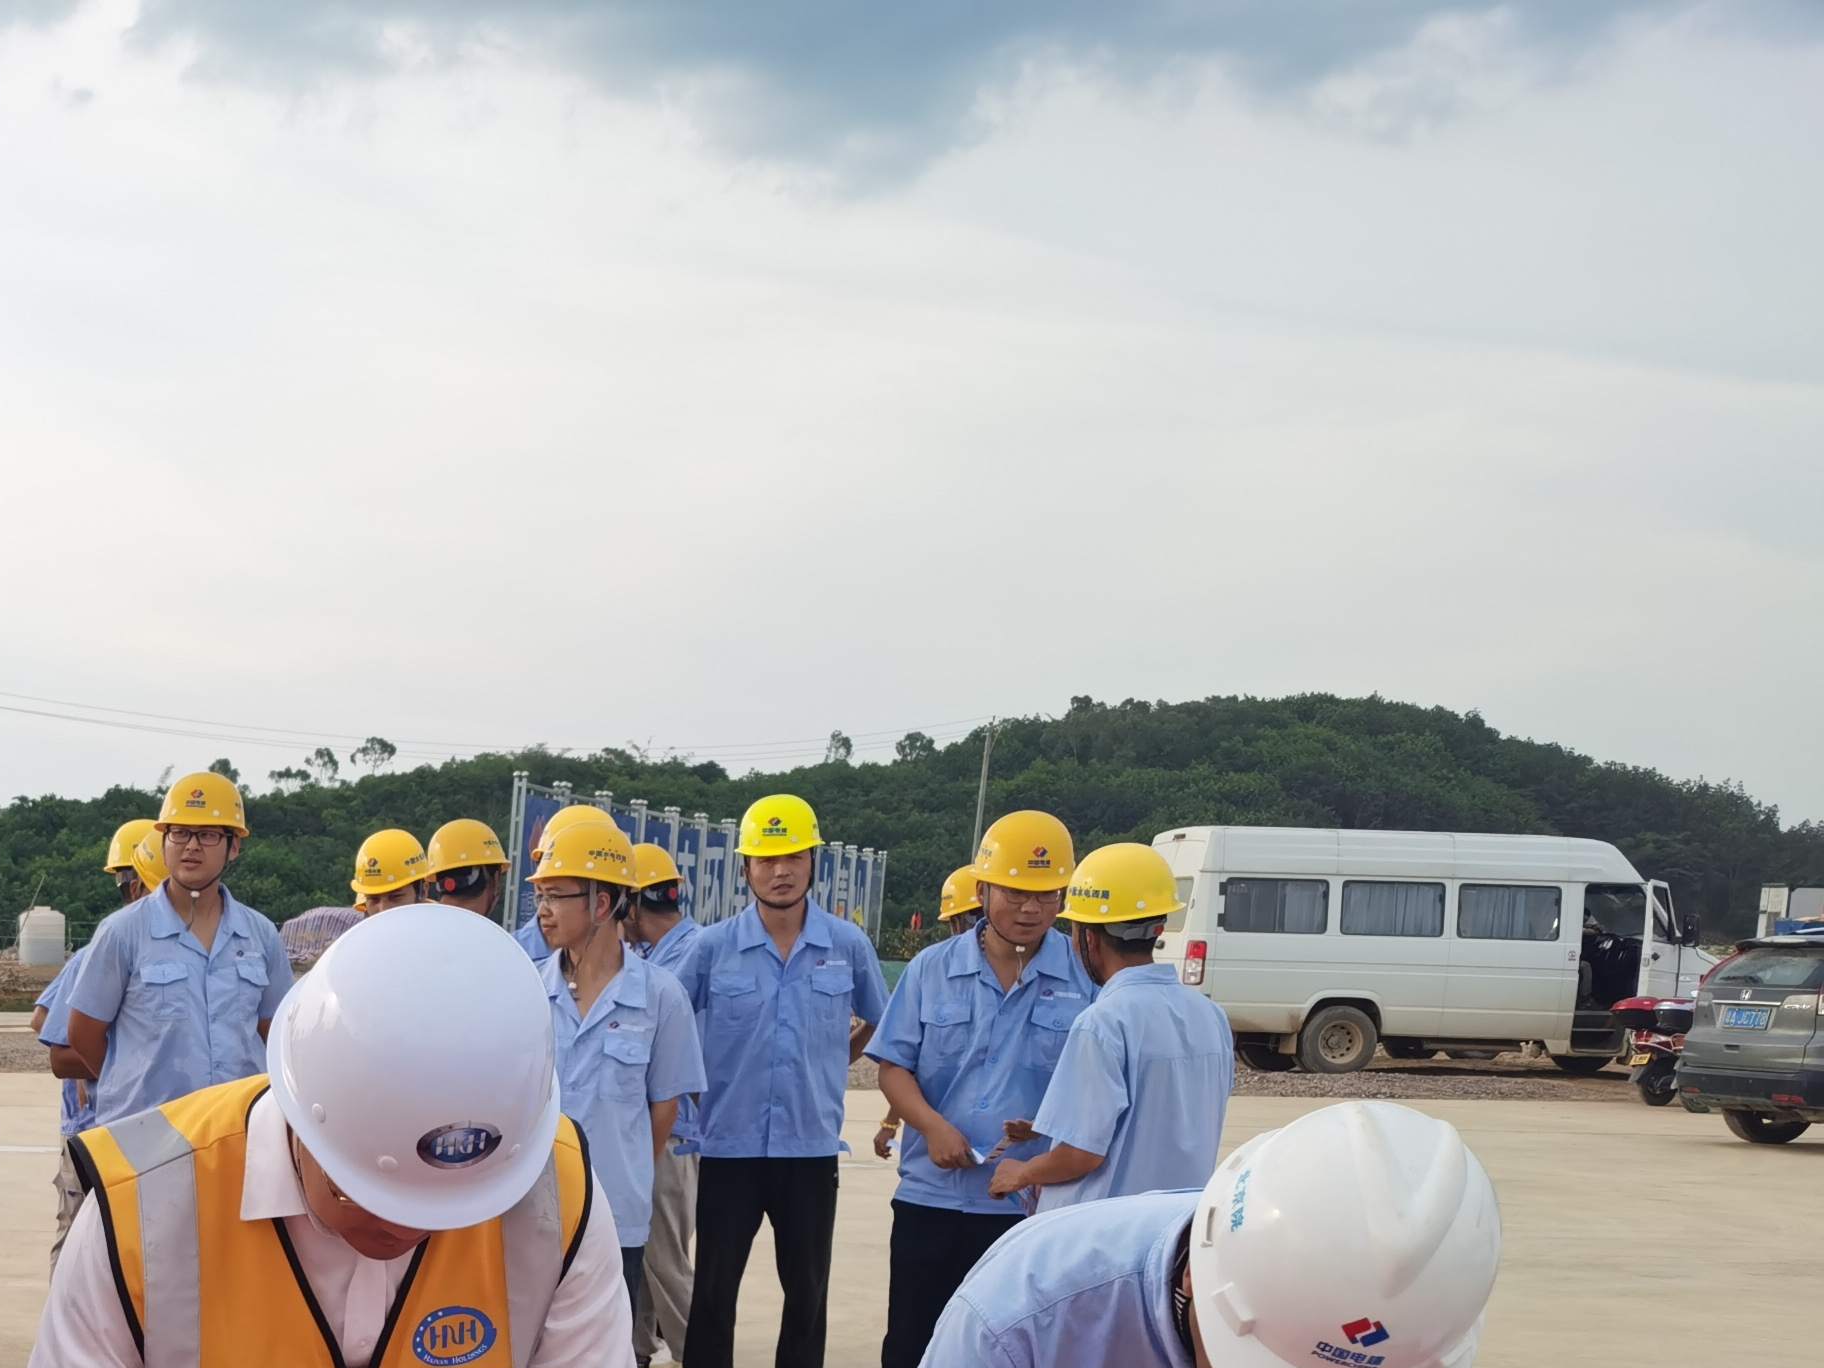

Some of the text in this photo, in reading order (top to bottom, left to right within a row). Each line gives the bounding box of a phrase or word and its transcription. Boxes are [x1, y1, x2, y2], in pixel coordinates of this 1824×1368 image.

[430, 1319, 477, 1350] HNH
[1316, 1341, 1386, 1366] 中国电建
